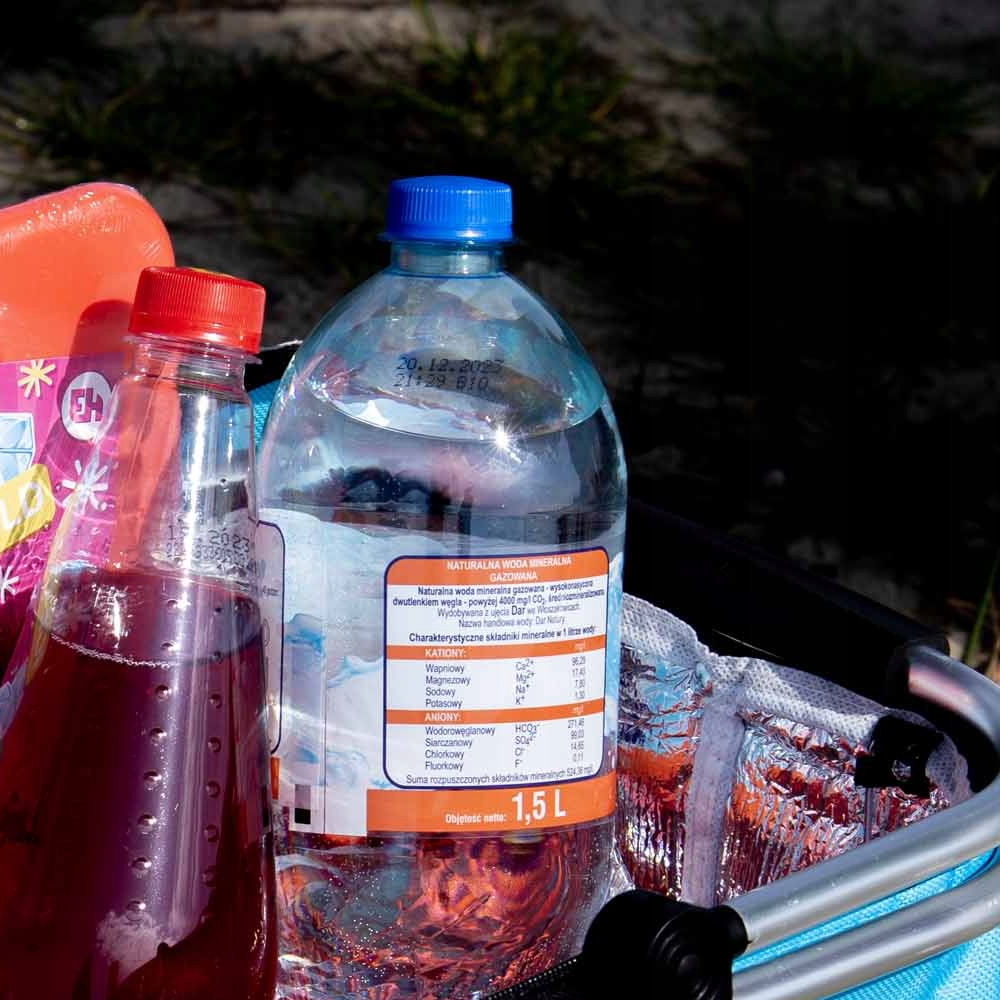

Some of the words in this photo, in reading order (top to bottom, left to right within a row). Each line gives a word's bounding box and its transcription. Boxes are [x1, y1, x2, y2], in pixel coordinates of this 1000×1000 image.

[447, 559, 500, 570] NATURALNA
[503, 559, 528, 569] WODA
[529, 556, 572, 568] MINERALNA
[489, 572, 537, 582] GAZOWANA
[418, 586, 453, 596] Naturalna
[455, 586, 475, 596] woda
[476, 585, 511, 596] mineralna
[512, 584, 545, 597] gazowana
[392, 596, 439, 606] dwutlenkiem
[441, 596, 462, 608] węgla
[468, 596, 497, 608] powyżej
[437, 608, 484, 620] Wydobywana
[511, 605, 526, 616] Dar
[458, 619, 482, 628] Nazwa
[409, 632, 484, 645] Charakterystyczne
[485, 630, 520, 642] składniki
[521, 629, 555, 640] mineralne
[424, 648, 467, 657] KATIONY:
[425, 663, 465, 675] Wapniowy
[425, 675, 471, 686] Magnezowy
[425, 686, 456, 698] Sodowy
[425, 698, 463, 709] Potasowy
[424, 712, 462, 722] ANIONY:
[425, 726, 496, 737] Wodorowęglanowy
[425, 737, 473, 748] Siarczanowy
[425, 749, 465, 760] Chlorkowy
[425, 761, 464, 772] Fluorkowy
[406, 774, 428, 784] Suma
[430, 773, 490, 784] rozpuszczonych
[512, 791, 547, 825] 1,5
[554, 788, 567, 817] L
